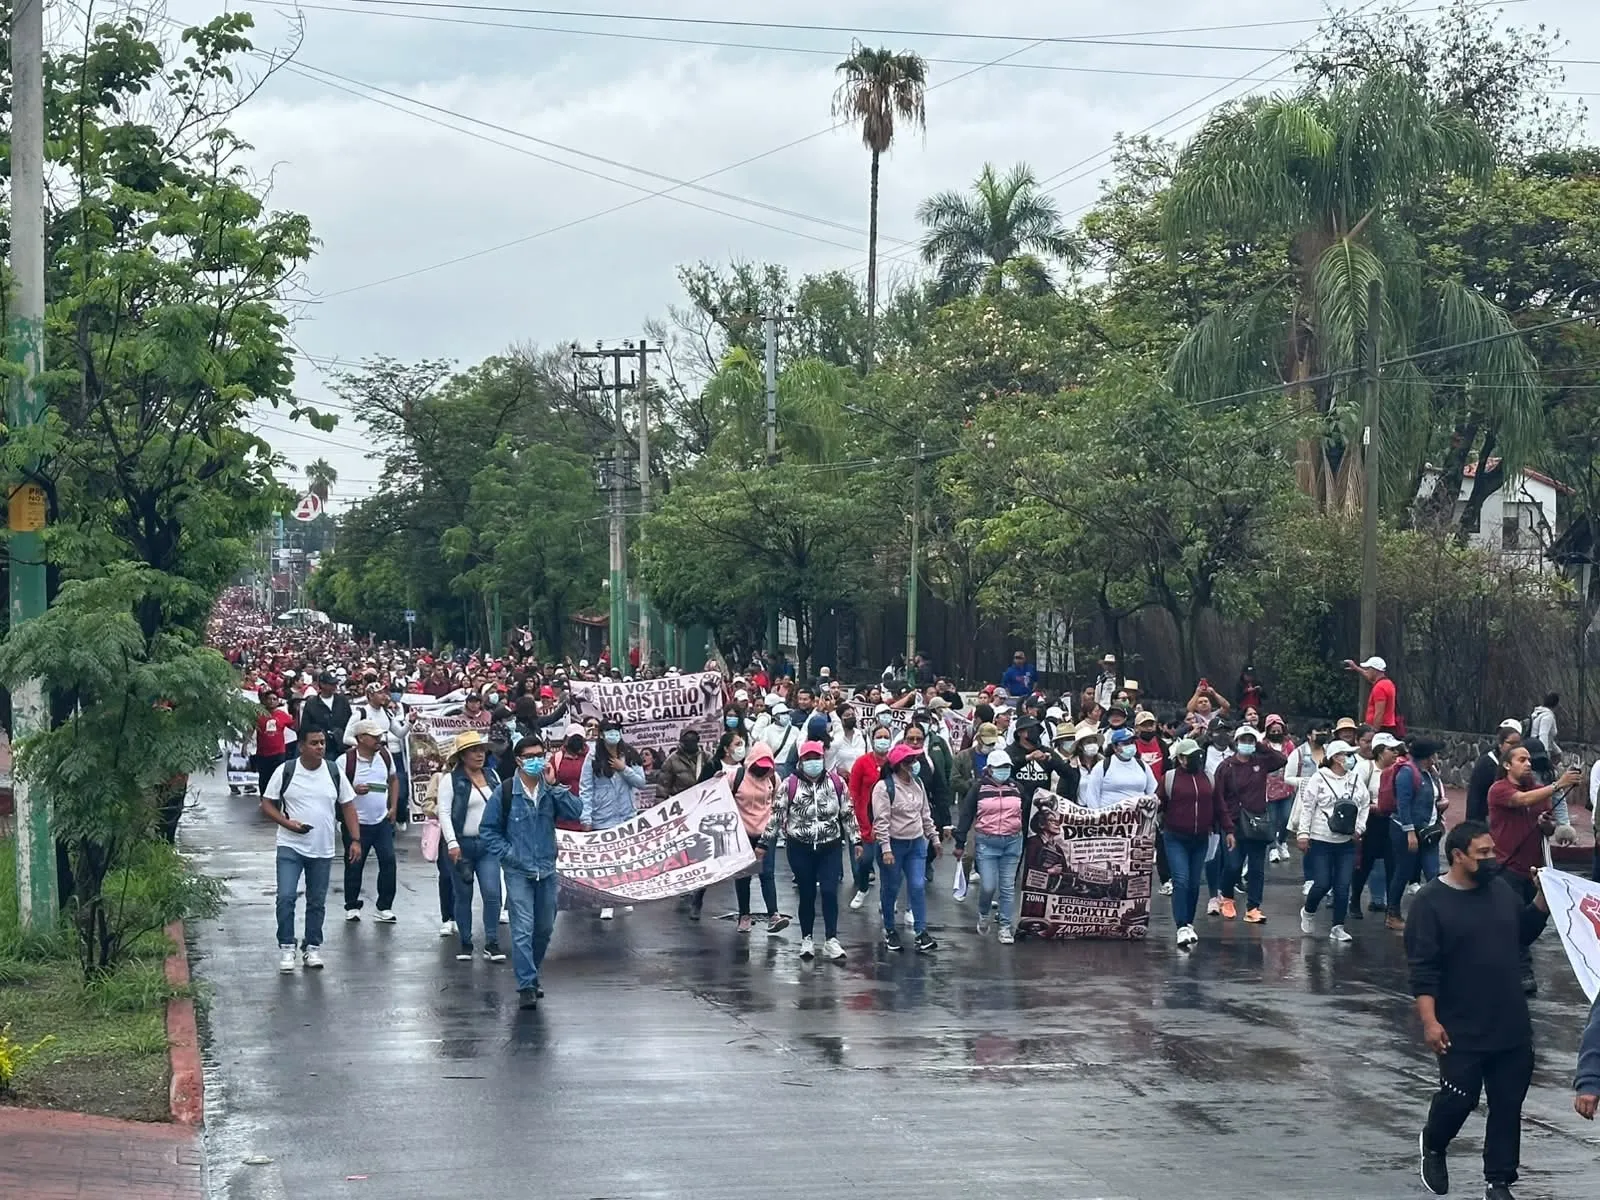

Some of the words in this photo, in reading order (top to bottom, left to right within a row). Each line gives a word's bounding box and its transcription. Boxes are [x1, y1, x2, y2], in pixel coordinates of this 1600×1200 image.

[599, 686, 622, 697] ¡LA
[625, 682, 654, 693] VOZ
[658, 679, 684, 690] DEL
[600, 687, 699, 712] MAGISTERIO
[602, 712, 623, 721] NO
[627, 710, 647, 722] SE
[652, 703, 703, 720] CALLA!
[416, 783, 427, 792] ZON
[584, 817, 652, 845] ZONA
[657, 800, 684, 821] 14
[1059, 808, 1141, 826] JUBILACIÓN
[1063, 825, 1133, 841] DIGNA!
[557, 823, 690, 863] YECAPIXTLA
[593, 867, 616, 878] DE
[621, 837, 697, 873] LABORES
[676, 866, 708, 881] 2007
[1051, 904, 1120, 918] YECAPIXTLA
[1063, 915, 1106, 924] MORELOS
[1056, 924, 1097, 934] ZAPATA
